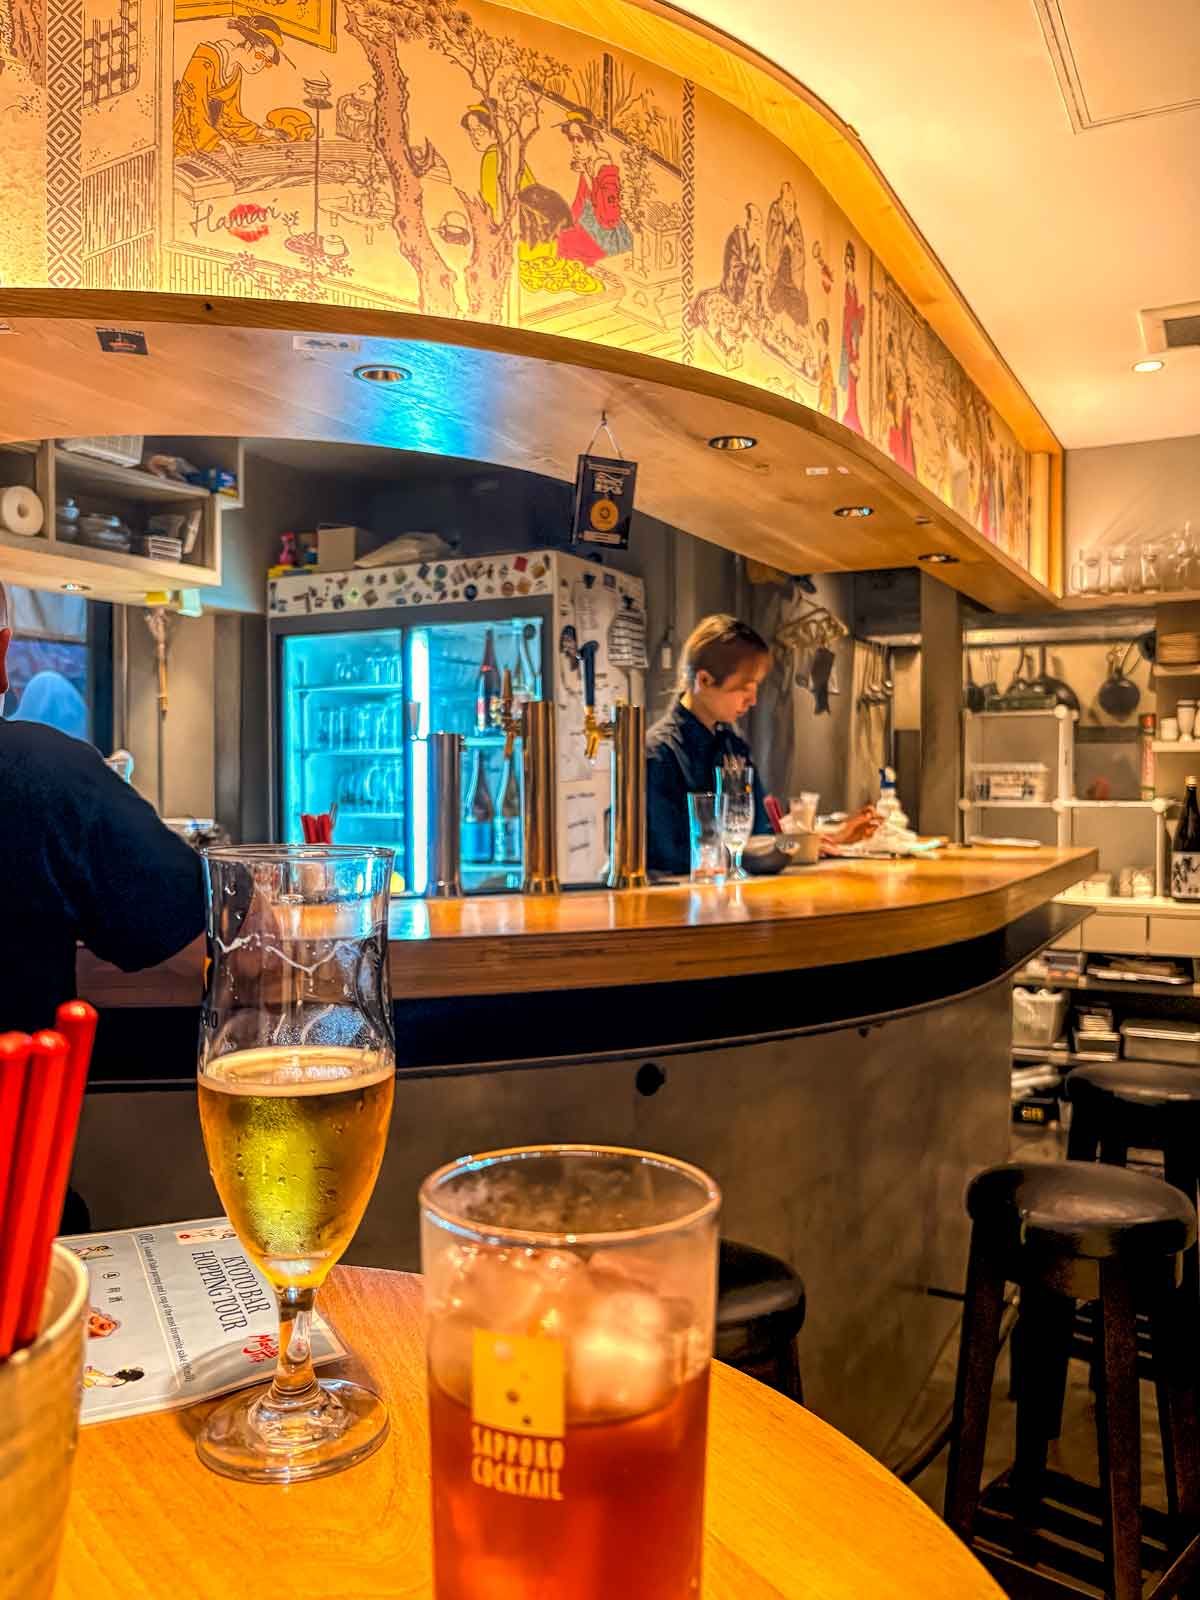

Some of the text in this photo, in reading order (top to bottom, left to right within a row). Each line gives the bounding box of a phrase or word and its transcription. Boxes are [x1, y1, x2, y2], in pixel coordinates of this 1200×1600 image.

[190, 198, 281, 237] Hannari
[191, 1250, 233, 1297] HOPPING
[213, 1296, 248, 1332] TOUR
[222, 1255, 271, 1314] KYOTO BAR
[167, 1316, 177, 1327] most
[471, 1425, 565, 1471] SAPPORO
[471, 1456, 564, 1501] COCKTAIL
